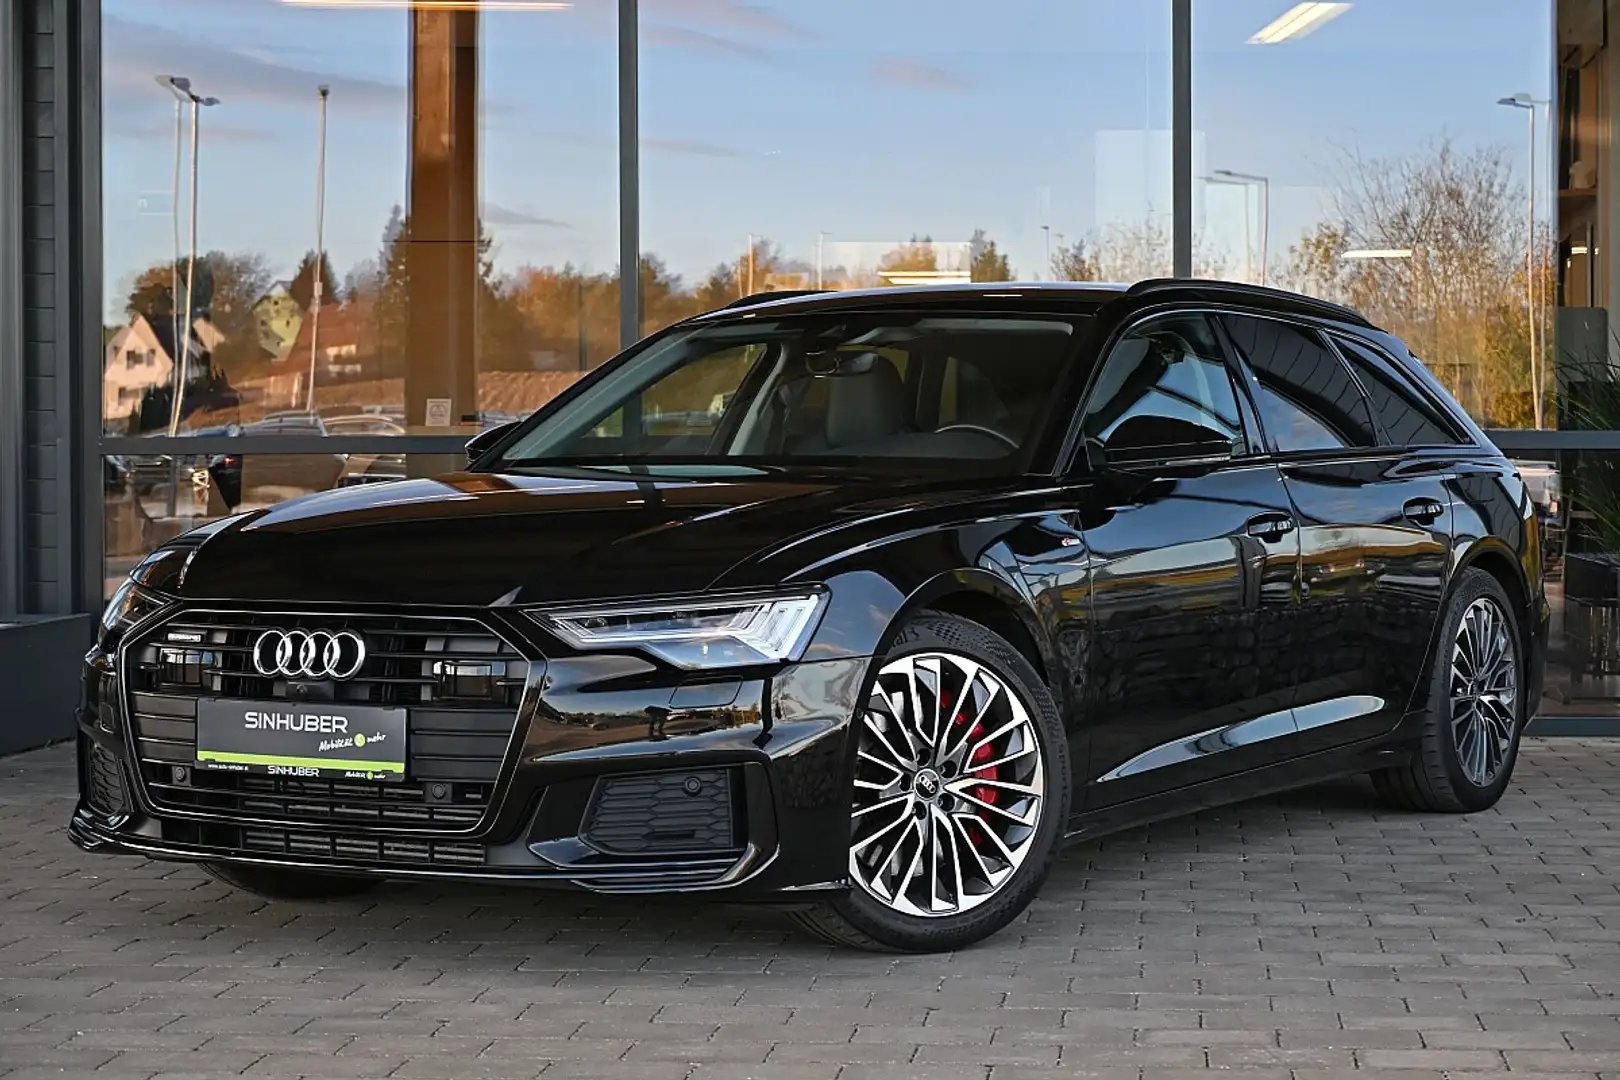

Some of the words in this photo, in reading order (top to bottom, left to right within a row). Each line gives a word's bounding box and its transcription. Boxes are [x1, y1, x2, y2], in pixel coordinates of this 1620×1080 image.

[244, 711, 349, 734] SINHUBER
[366, 731, 387, 743] mehr
[267, 765, 320, 777] SINHUBER
